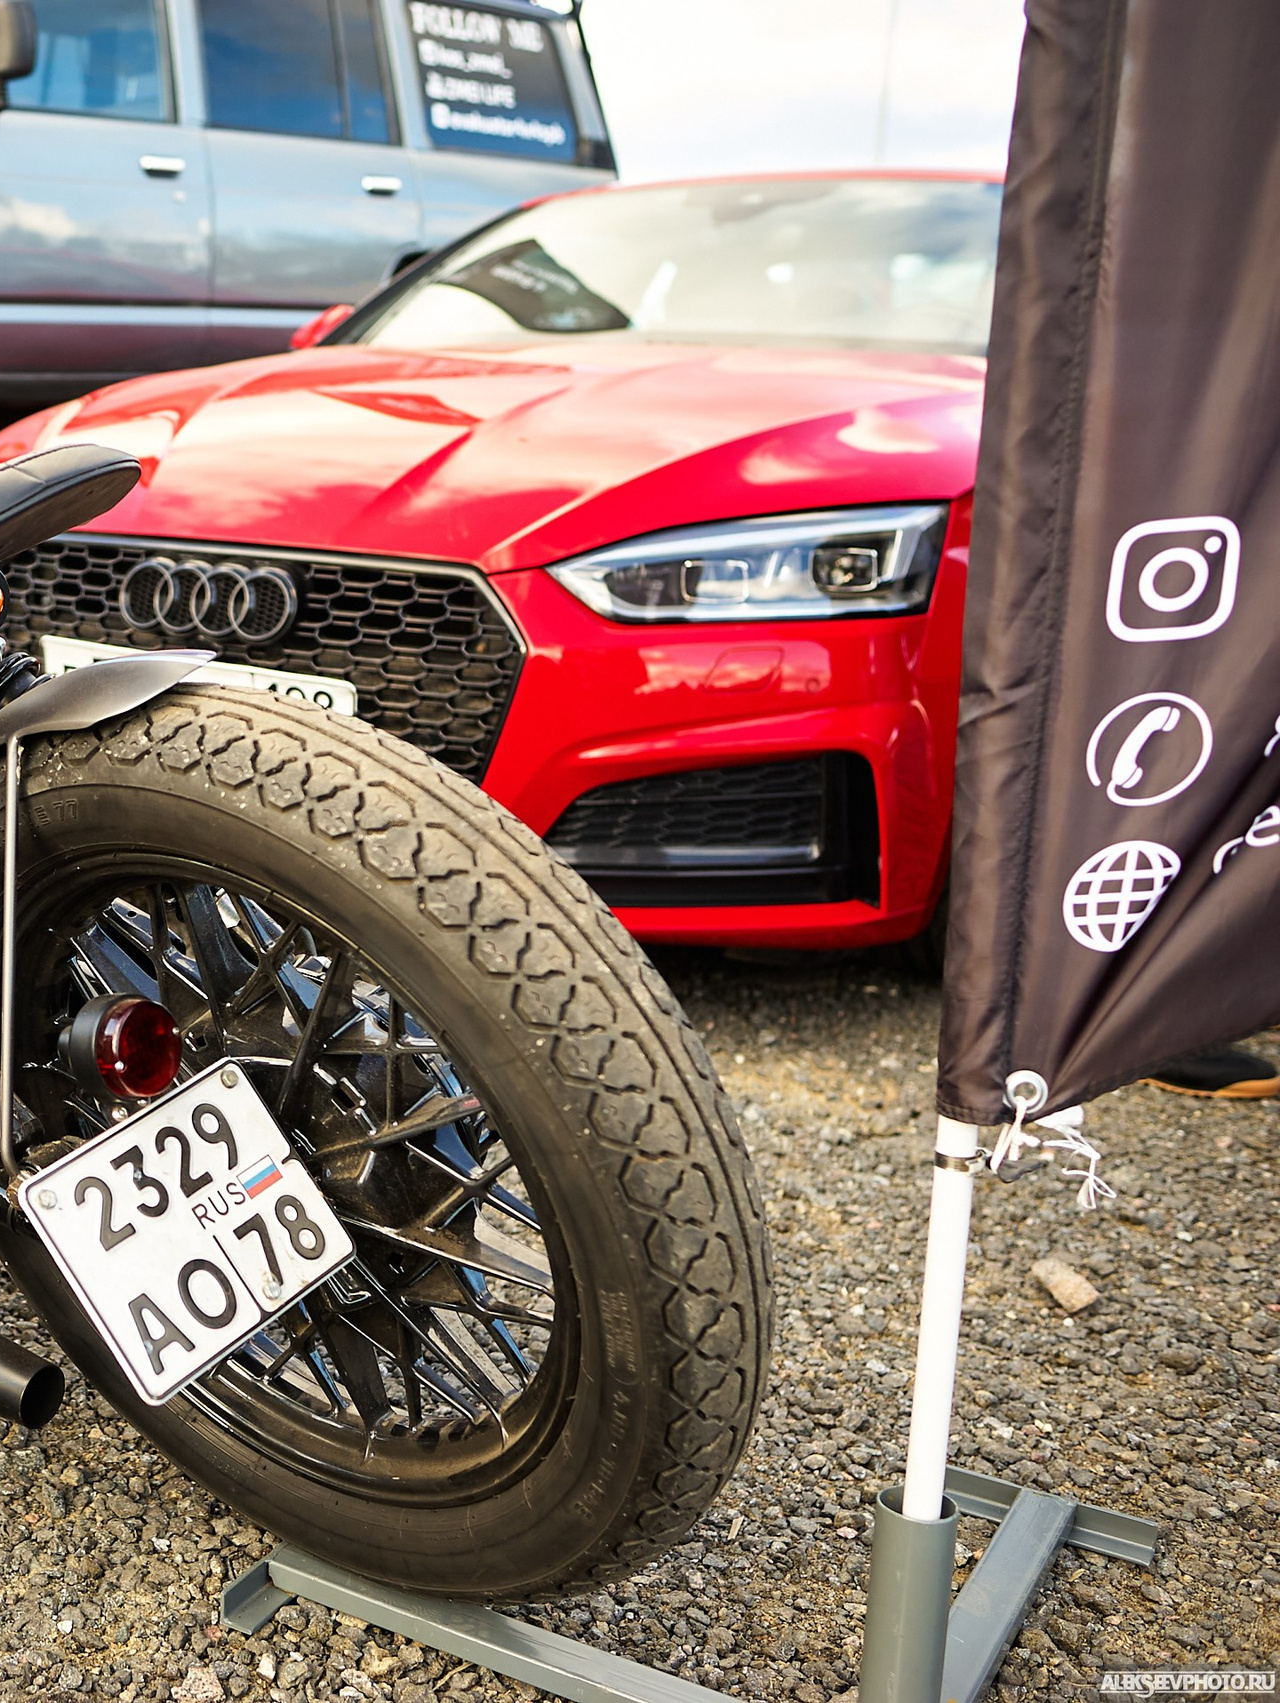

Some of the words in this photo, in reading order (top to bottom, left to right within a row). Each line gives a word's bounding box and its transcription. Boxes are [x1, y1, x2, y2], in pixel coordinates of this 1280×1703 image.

[53, 798, 79, 822] 77
[74, 1102, 239, 1252] 2329
[191, 1182, 247, 1230] RUS
[233, 1194, 326, 1287] 78
